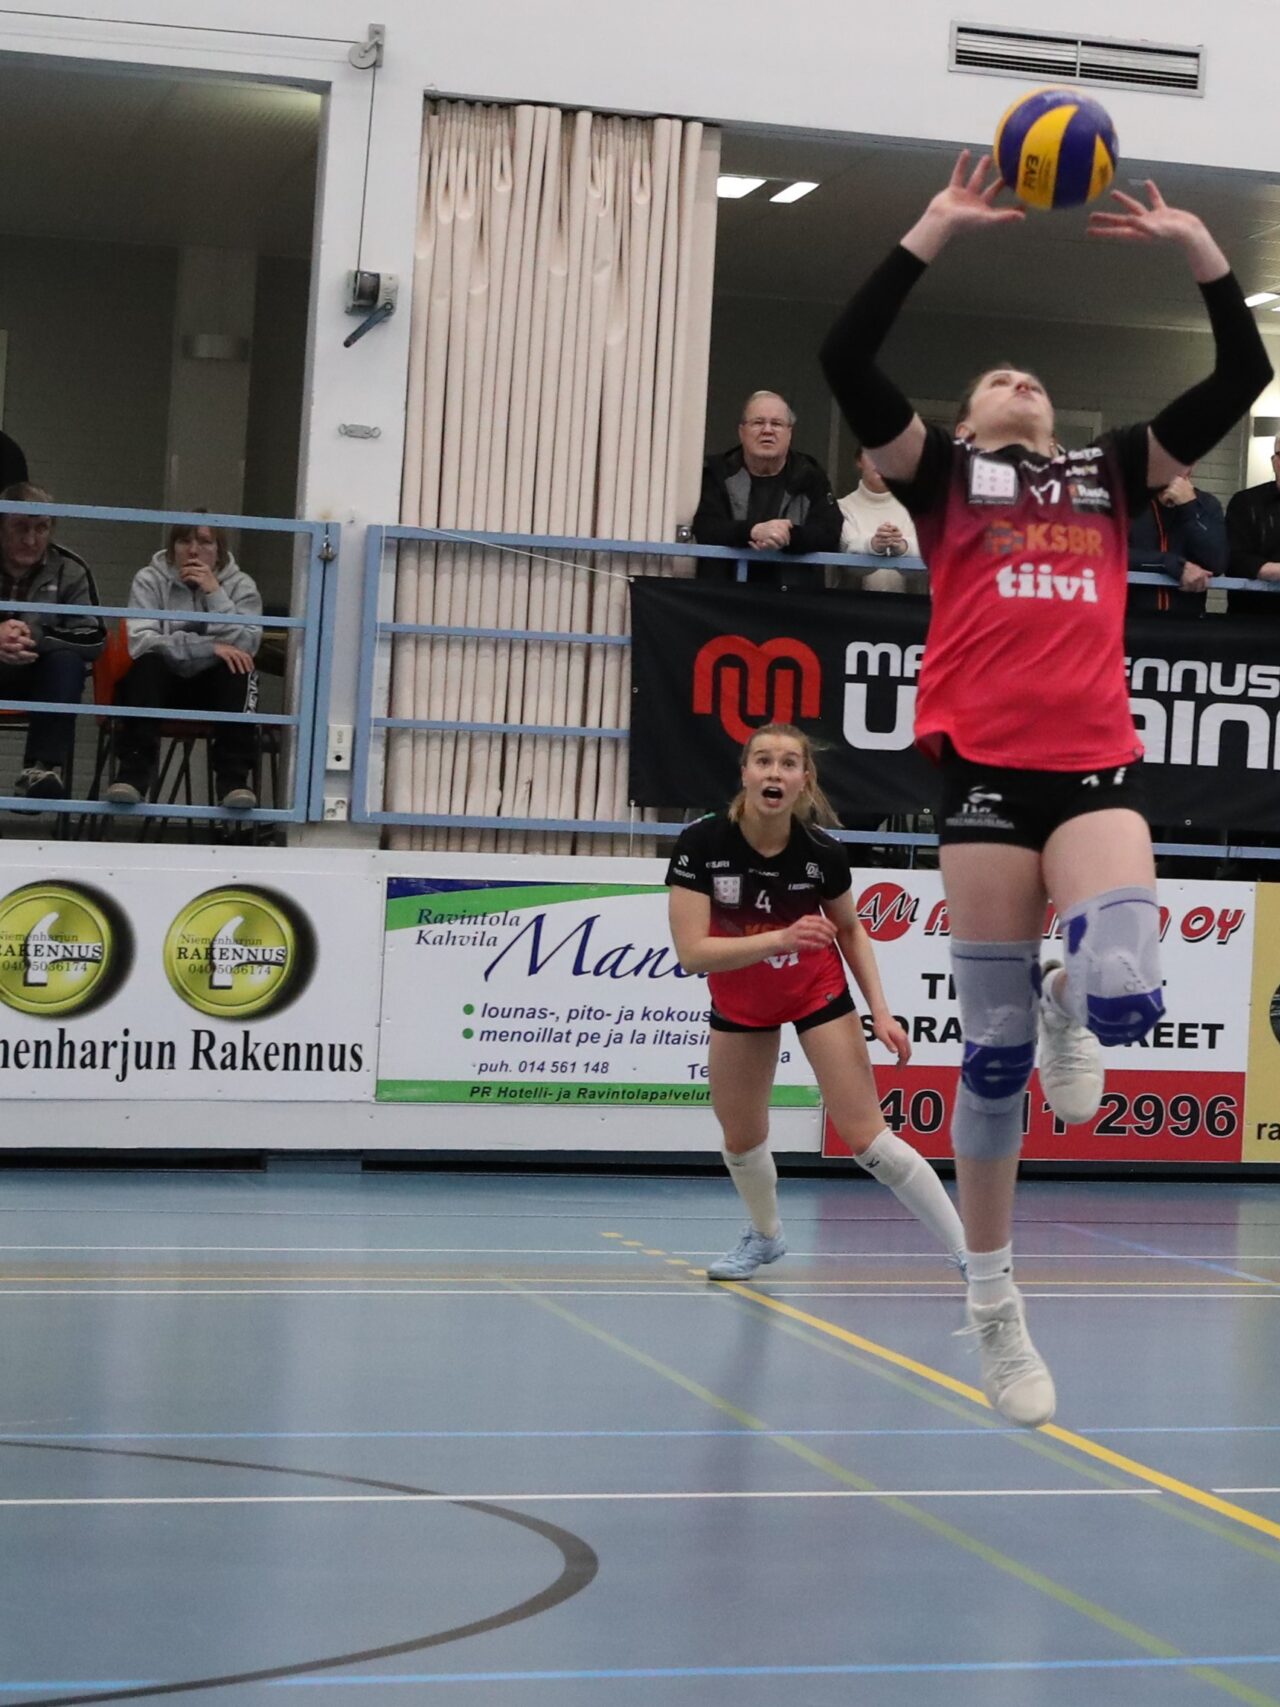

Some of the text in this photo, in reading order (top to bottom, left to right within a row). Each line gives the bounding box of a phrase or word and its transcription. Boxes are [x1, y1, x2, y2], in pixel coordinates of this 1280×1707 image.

[1025, 522, 1104, 556] KSBR
[996, 562, 1098, 603] tiivi
[755, 889, 772, 914] 4
[416, 907, 521, 928] Ravintola
[1180, 906, 1245, 944] OY
[0, 942, 102, 959] AKENNUS
[415, 930, 498, 948] Kahvila
[176, 945, 286, 962] RAKENNUS
[480, 1002, 561, 1024] lounas-,
[566, 1007, 613, 1027] pito-
[617, 1008, 635, 1027] ja
[479, 1028, 571, 1045] menoillat
[577, 1032, 600, 1050] pe
[604, 1030, 623, 1050] ja
[629, 1029, 648, 1046] la
[189, 1029, 364, 1073] Rakennus
[478, 1060, 610, 1077] puh. 014 561 148
[470, 1085, 492, 1098] PR
[497, 1085, 554, 1100] Hotelli-
[556, 1087, 571, 1102] ja
[1094, 1092, 1238, 1138] 2996
